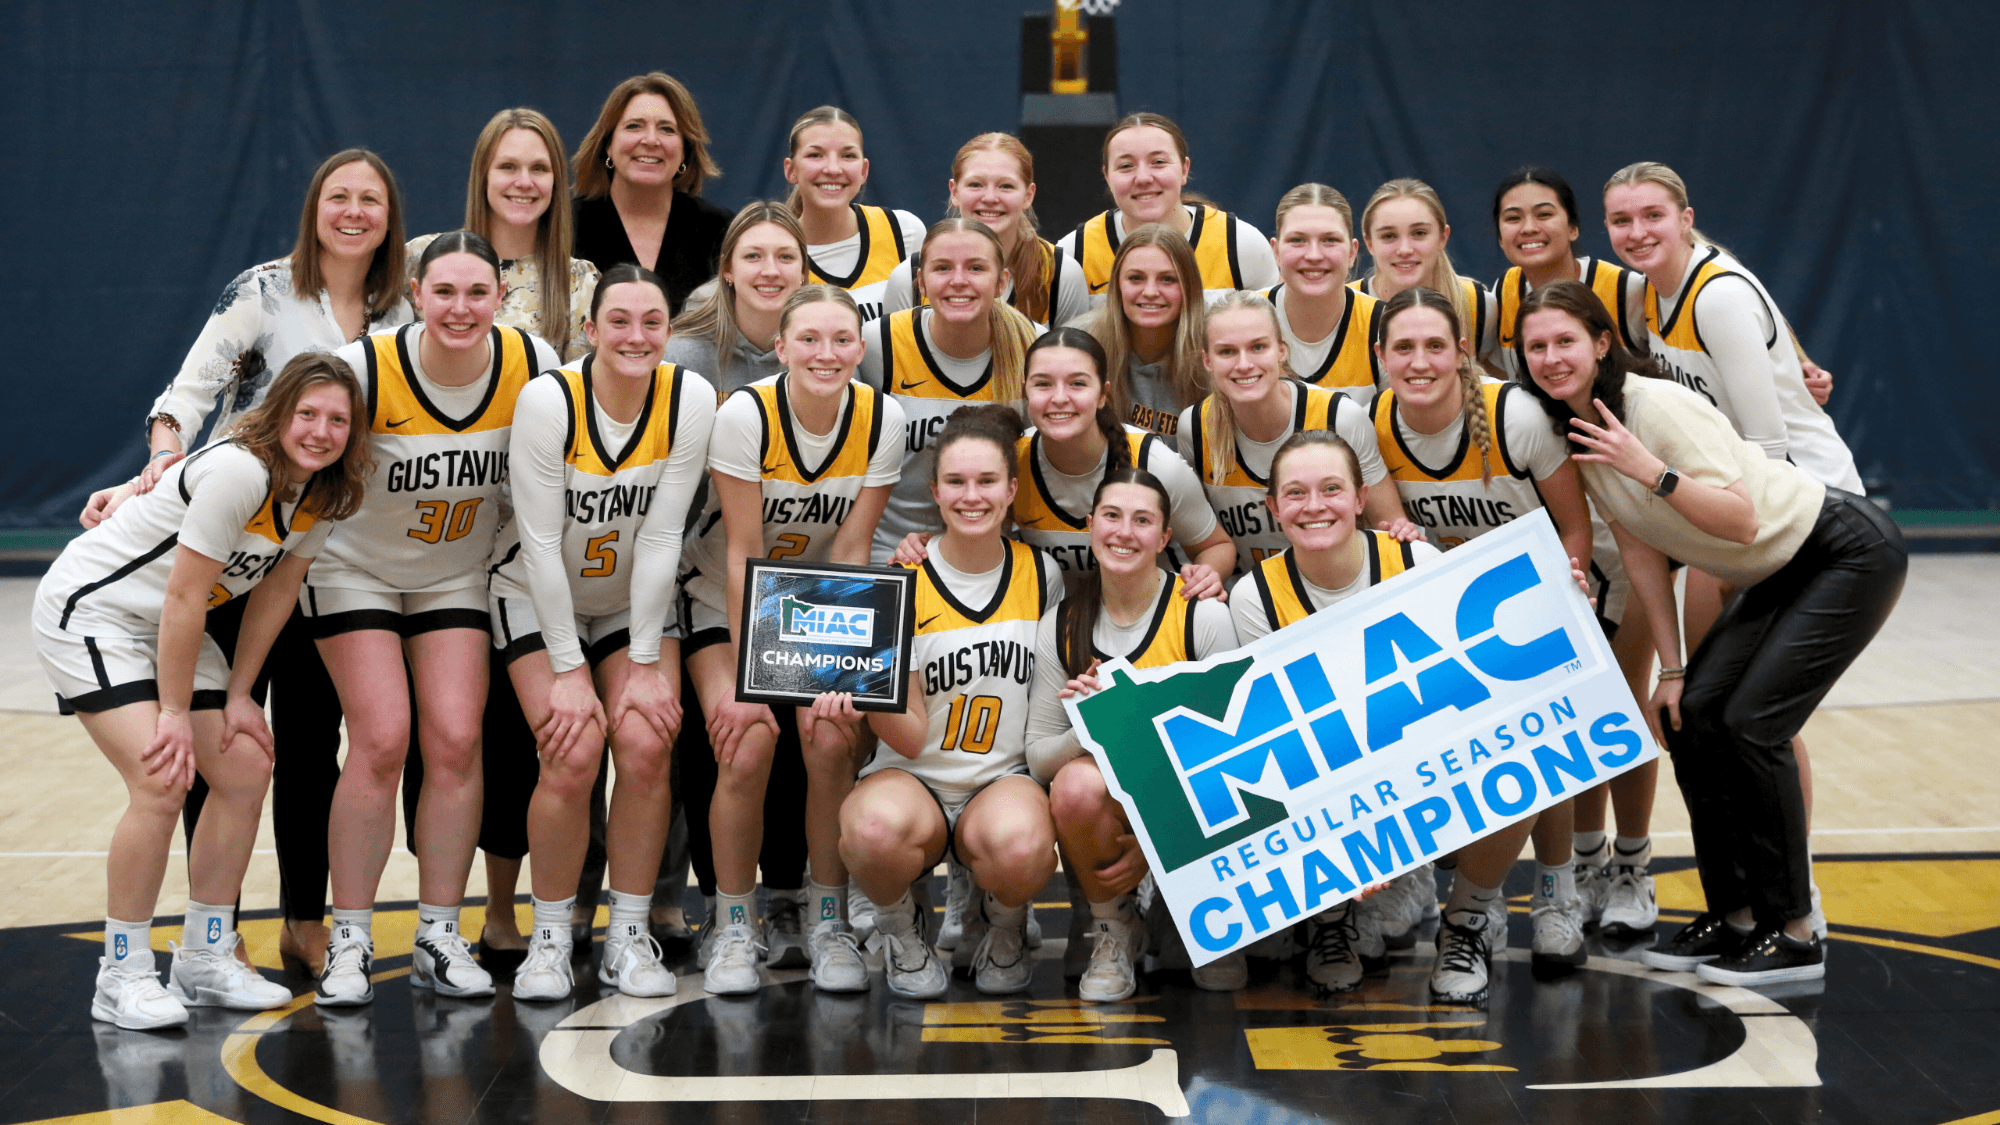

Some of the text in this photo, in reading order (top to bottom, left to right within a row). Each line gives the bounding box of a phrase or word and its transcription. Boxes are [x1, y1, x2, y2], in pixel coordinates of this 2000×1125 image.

[407, 497, 484, 544] 30
[565, 484, 657, 524] USTAVU
[580, 530, 619, 577] 5
[793, 609, 868, 636] MIAC
[762, 650, 884, 672] CHAMPIONS
[1162, 551, 1578, 827] MIAC
[940, 693, 1002, 754] 10
[1211, 696, 1577, 882] REGULAR SEASON
[1188, 711, 1643, 953] CHAMPIONS
